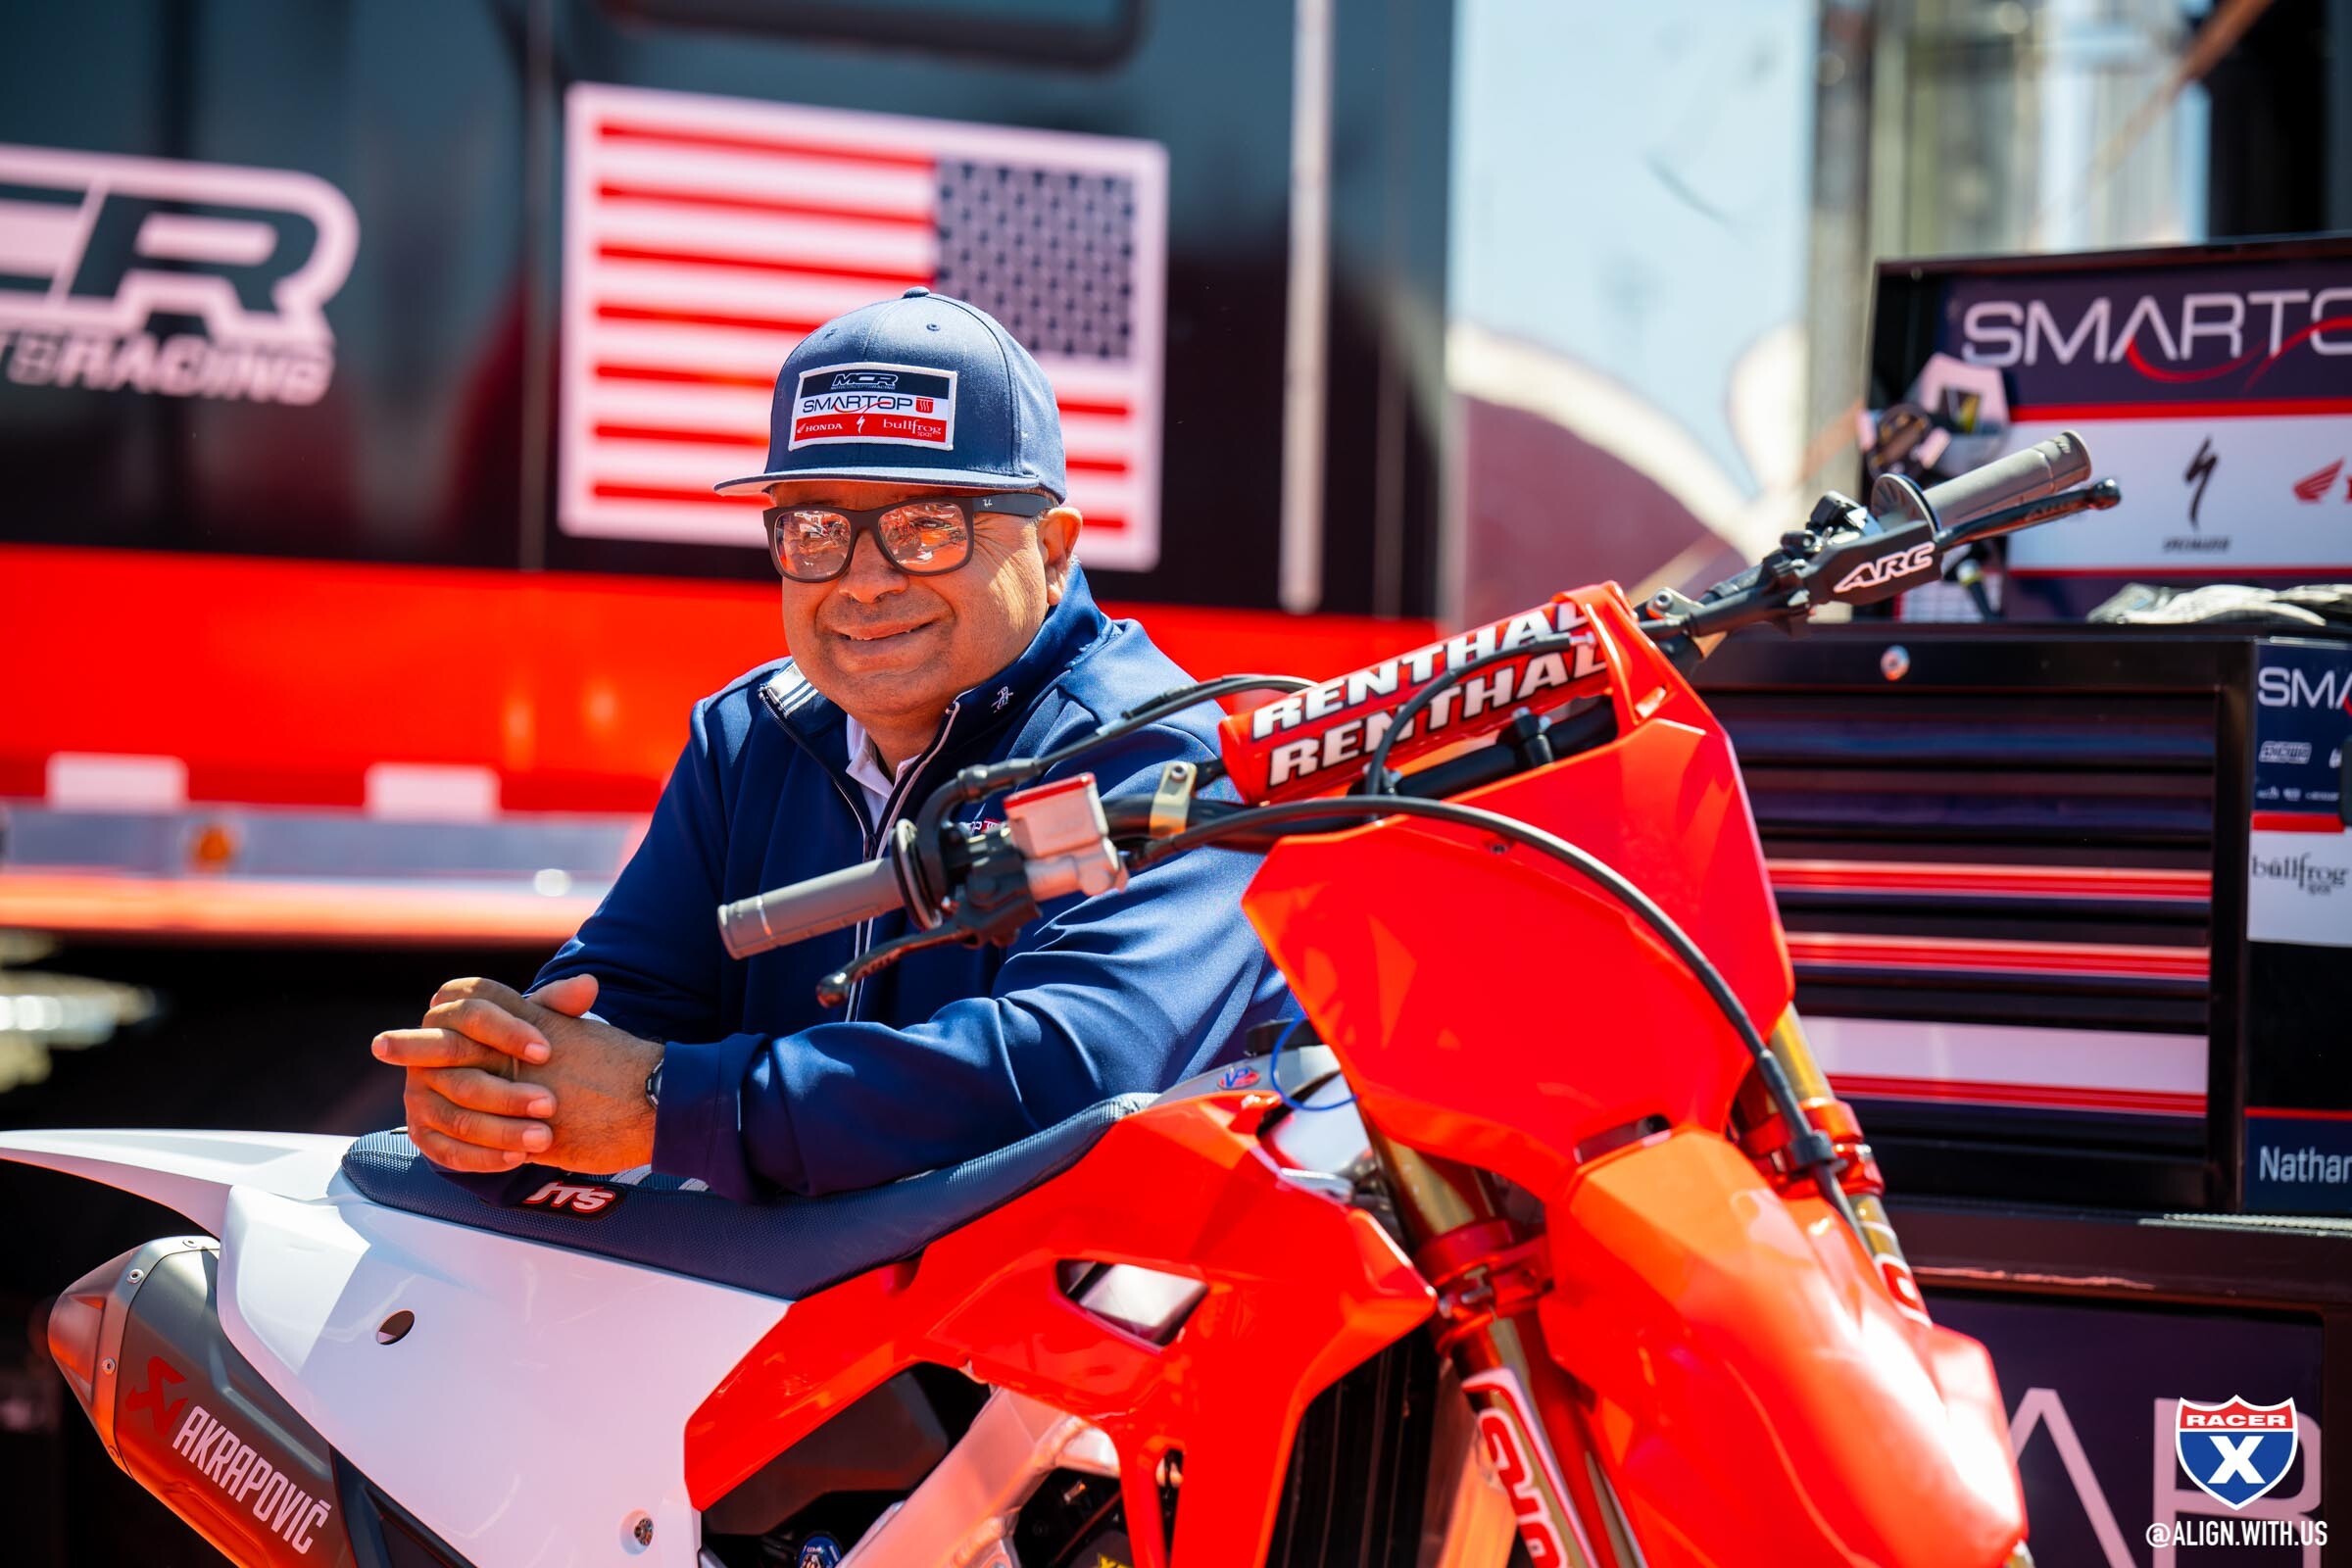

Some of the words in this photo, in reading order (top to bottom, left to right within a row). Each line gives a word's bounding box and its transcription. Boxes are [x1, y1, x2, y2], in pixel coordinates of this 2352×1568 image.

[832, 372, 899, 387] MCR
[803, 395, 913, 414] SMARTOP
[806, 422, 843, 432] HONDA
[883, 418, 942, 435] bullfrog
[1833, 542, 1936, 594] ARC
[1250, 600, 1589, 742] RENTHAL
[1268, 643, 1607, 786] RENTHAL
